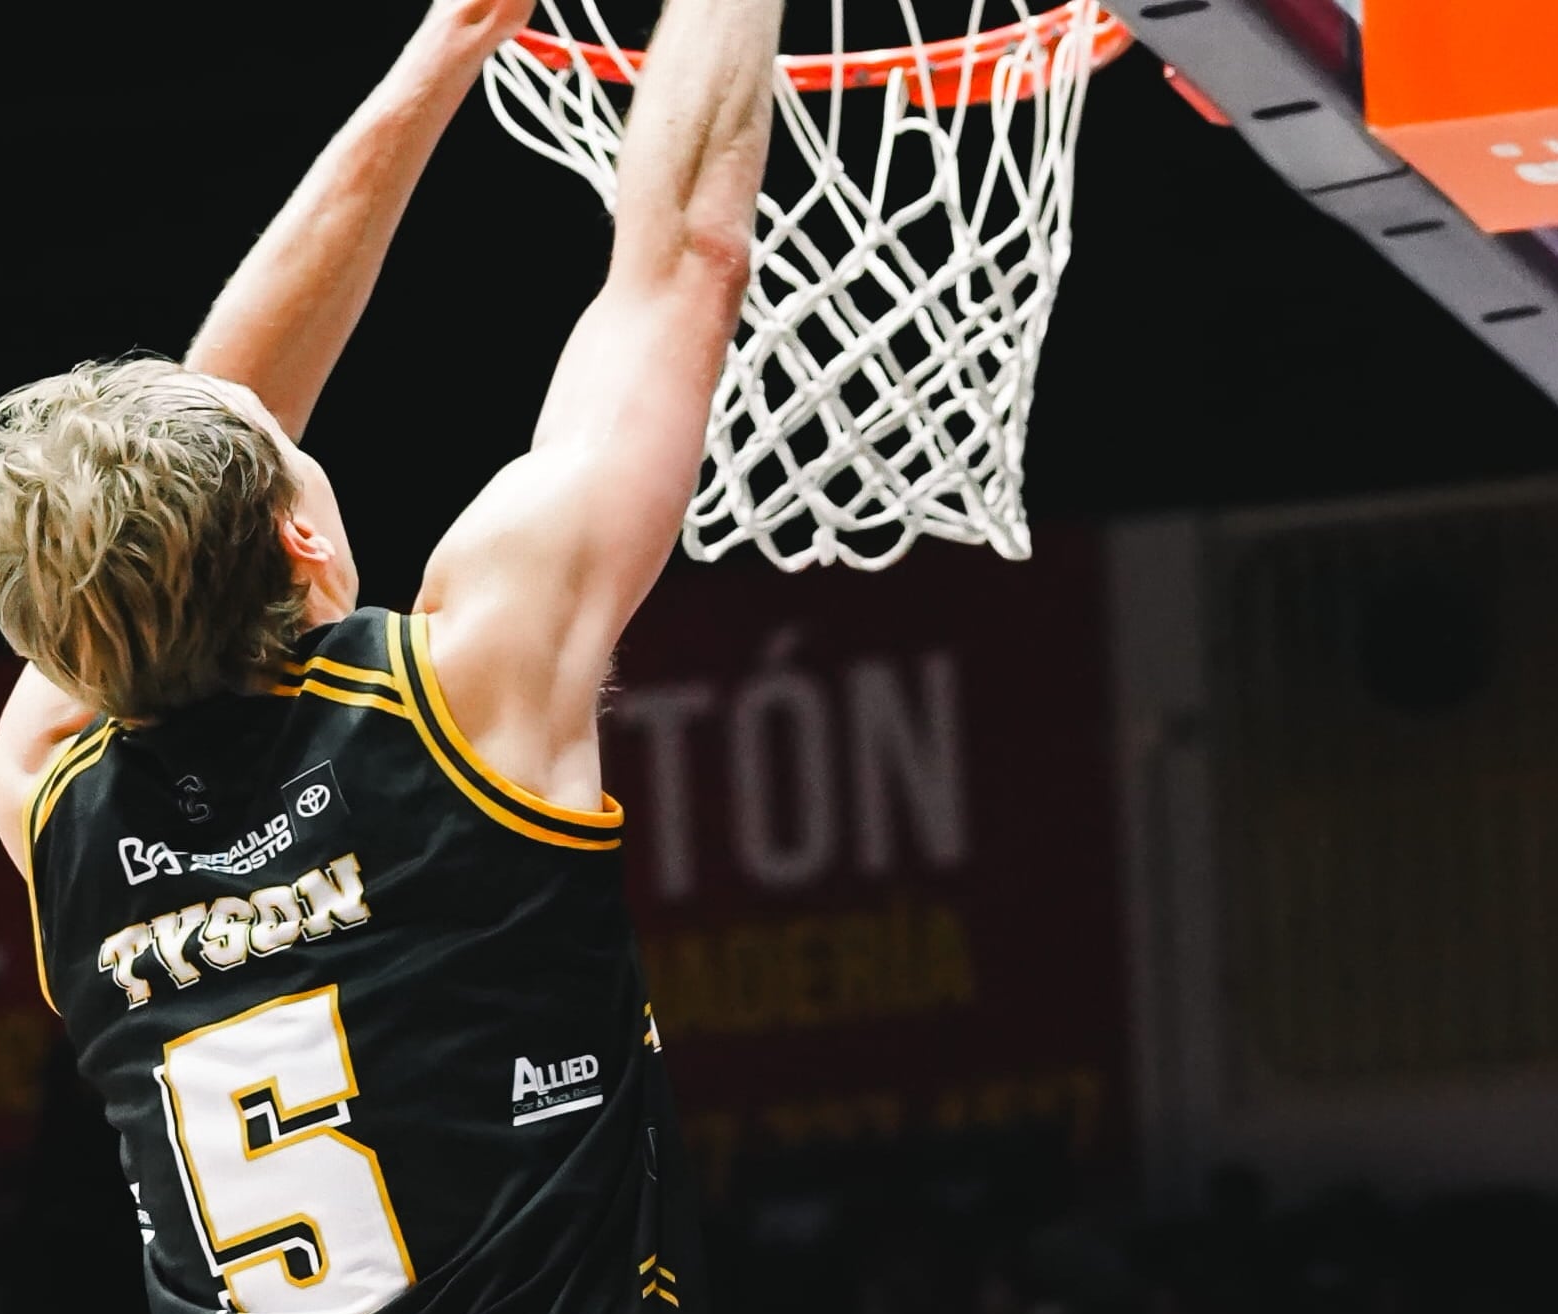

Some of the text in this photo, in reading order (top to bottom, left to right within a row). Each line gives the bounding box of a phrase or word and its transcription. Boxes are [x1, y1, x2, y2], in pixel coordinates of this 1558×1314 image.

[615, 626, 971, 896] TÓN
[98, 853, 371, 1010] TYSON
[512, 1054, 599, 1102] ALLIED
